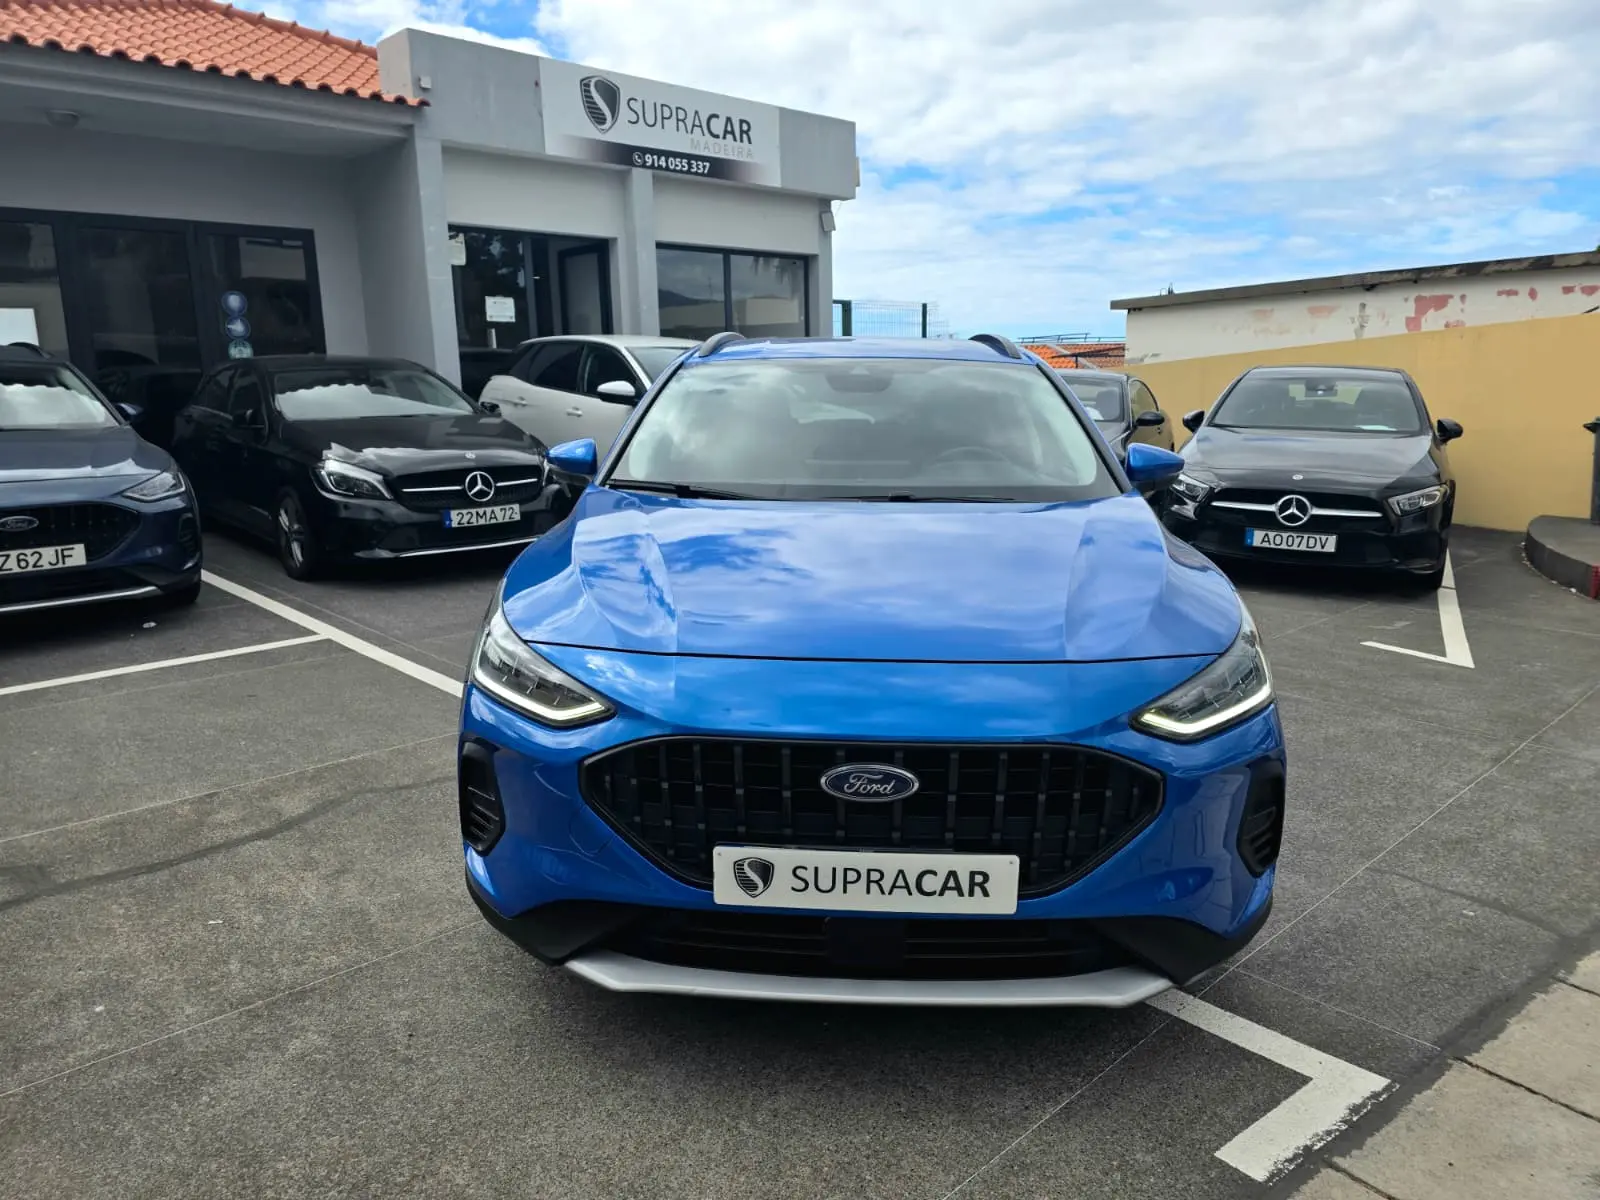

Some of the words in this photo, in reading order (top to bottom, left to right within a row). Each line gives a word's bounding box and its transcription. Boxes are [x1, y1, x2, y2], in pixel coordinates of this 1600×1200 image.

[626, 97, 753, 145] SUPRACAR
[690, 138, 753, 159] MADEIRA
[644, 153, 667, 169] 914
[668, 159, 688, 171] 055
[690, 162, 710, 174] 337
[843, 773, 896, 794] Ford
[790, 865, 991, 898] SUPRACAR
